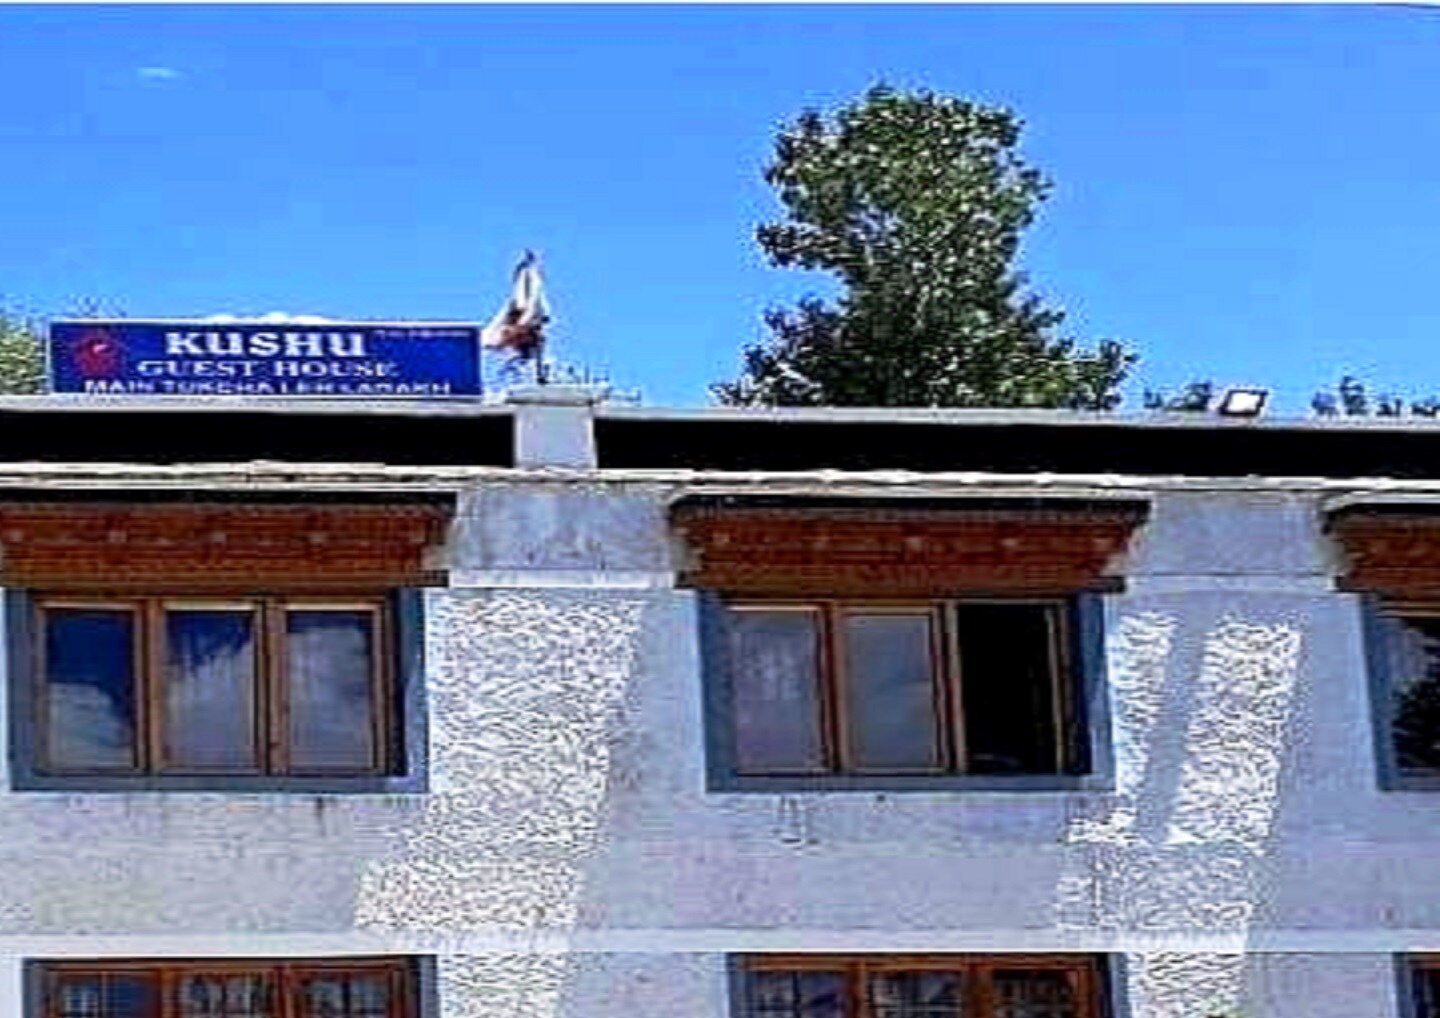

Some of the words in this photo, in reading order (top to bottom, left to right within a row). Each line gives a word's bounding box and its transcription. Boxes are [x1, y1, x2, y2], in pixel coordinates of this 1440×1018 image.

[165, 332, 366, 356] KUSHU
[137, 360, 259, 377] GUEST
[275, 360, 399, 377] HOUSE
[84, 379, 156, 395] MAIN
